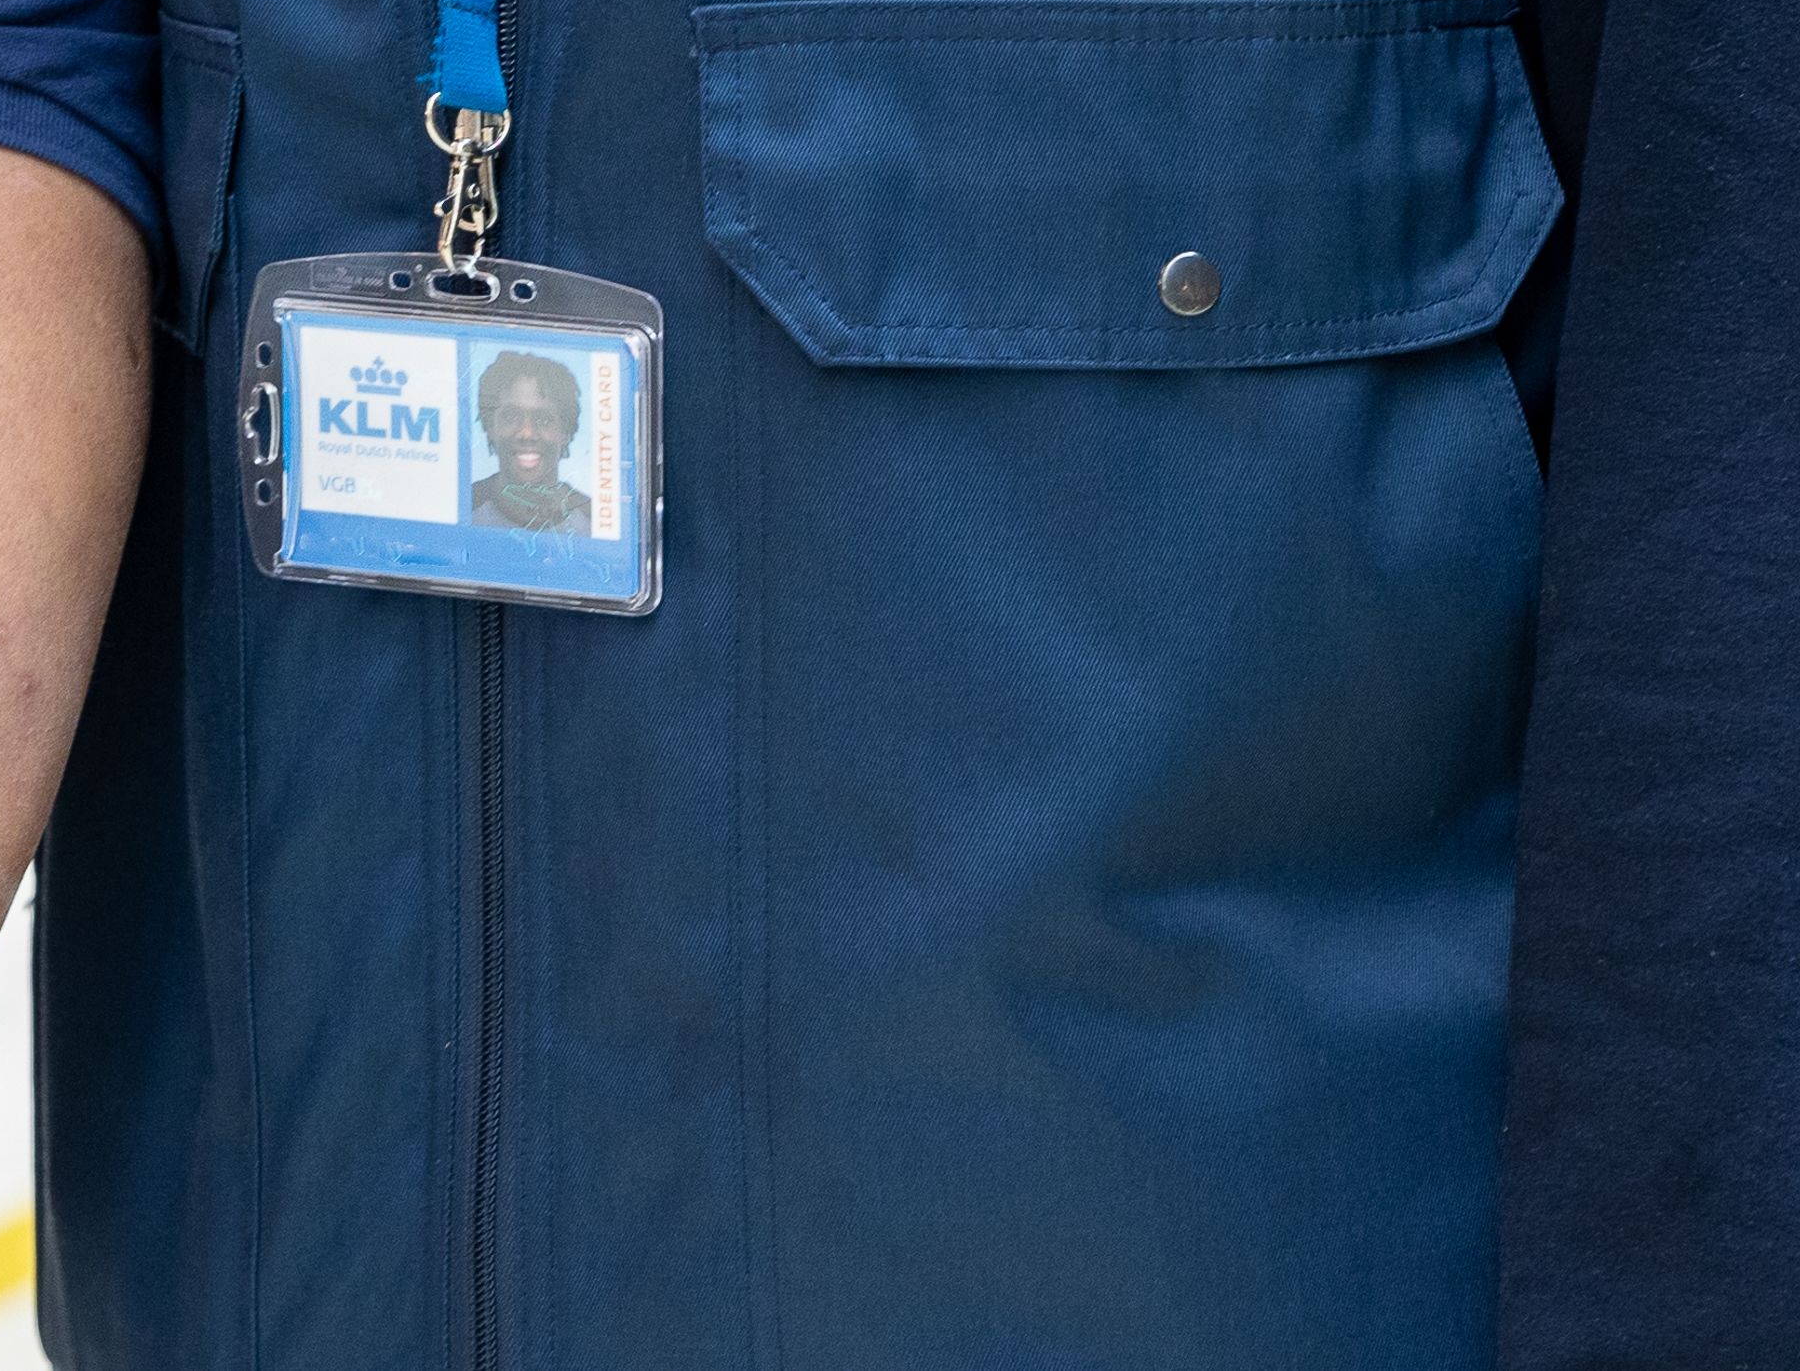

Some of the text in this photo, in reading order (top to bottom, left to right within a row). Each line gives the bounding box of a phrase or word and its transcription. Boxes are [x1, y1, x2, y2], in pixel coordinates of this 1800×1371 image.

[318, 397, 441, 444] KLM
[598, 365, 613, 529] IDENTITY CARD
